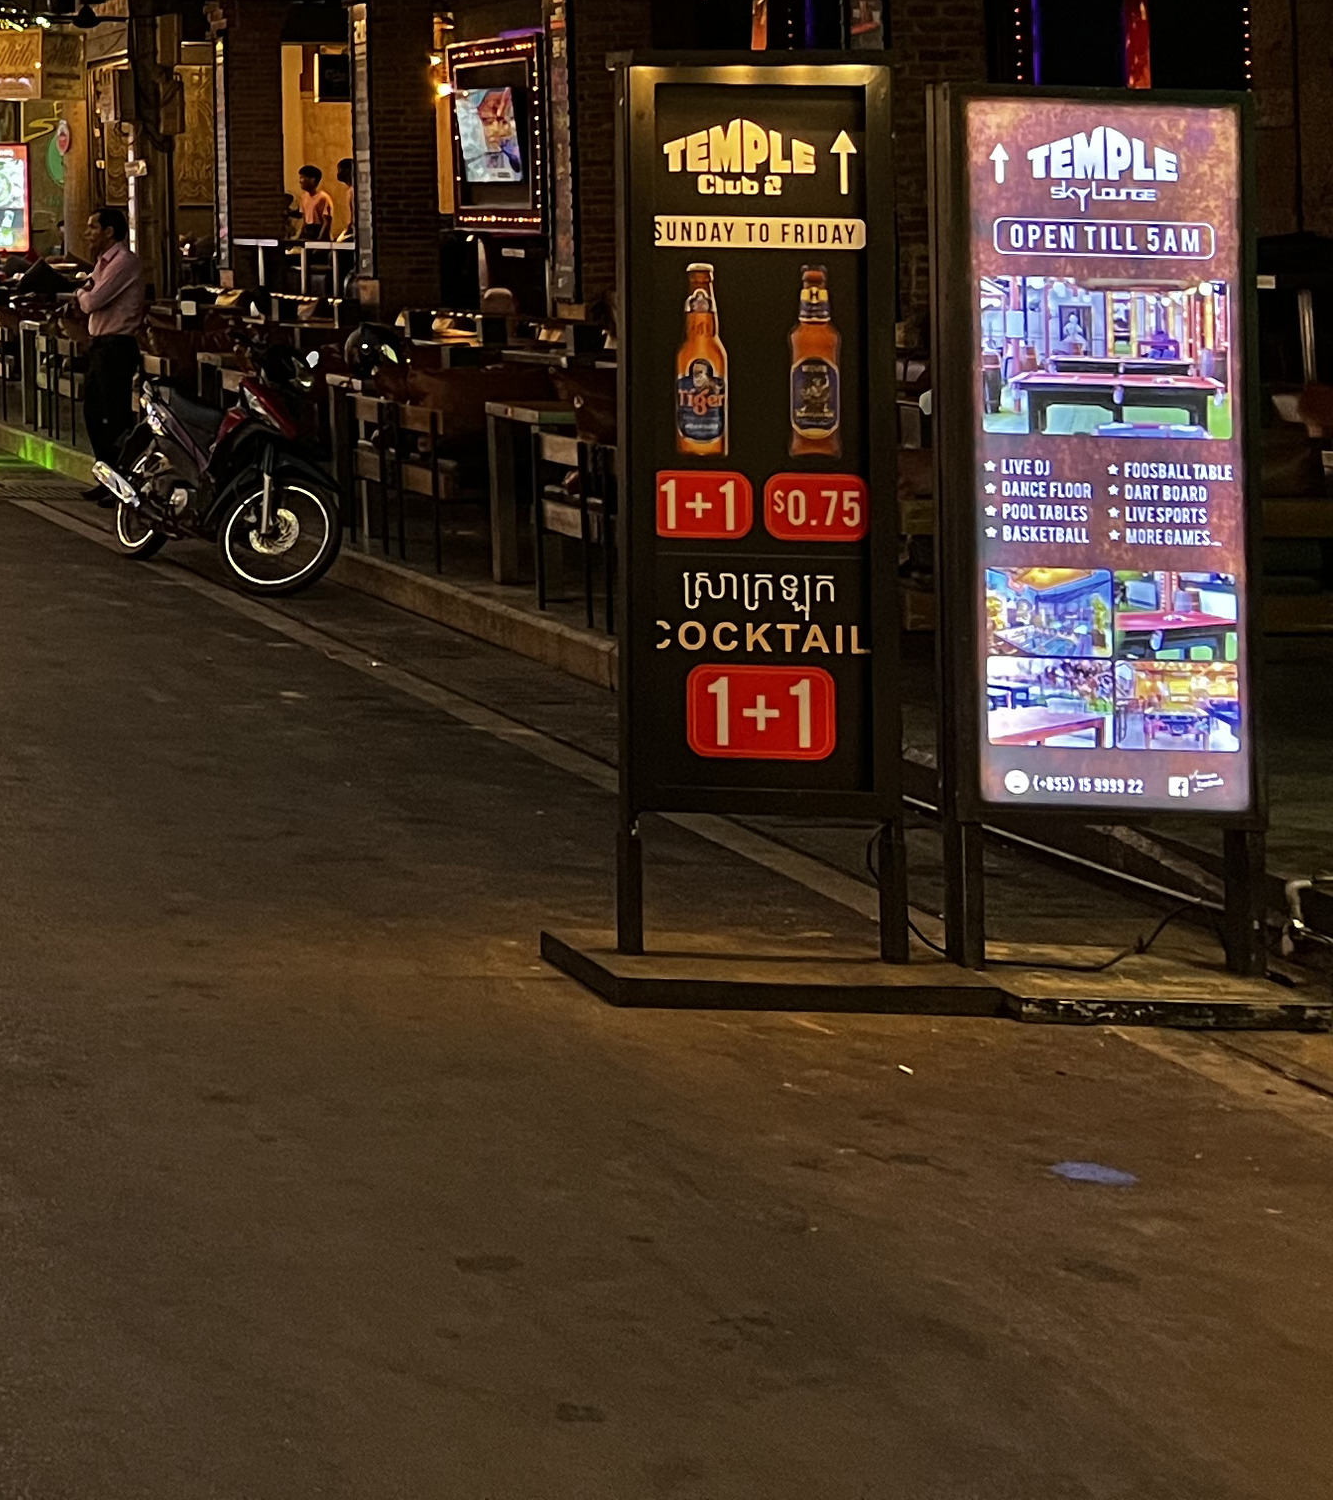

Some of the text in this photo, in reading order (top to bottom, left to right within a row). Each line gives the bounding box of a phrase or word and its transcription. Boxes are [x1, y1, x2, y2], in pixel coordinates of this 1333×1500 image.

[663, 118, 817, 174] TEMPLE
[1026, 125, 1180, 182] TEMPLE
[697, 174, 783, 196] Club 2
[654, 220, 857, 245] SUNDAY TO FRIDAY
[1009, 223, 1201, 253] OPEN TILL 5AM
[677, 388, 725, 416] Tiger
[1000, 458, 1051, 476] LIVE DJ
[1123, 461, 1234, 482] FOOSBALL TABLE
[1001, 480, 1093, 499] DANCE FLOOR
[1124, 484, 1208, 503] DART BOARD
[659, 478, 735, 532] 1+1
[772, 488, 862, 527] $0.75
[1001, 503, 1089, 522] POOL TABLES
[1124, 506, 1208, 525] LIVE SPORTS
[1001, 525, 1090, 545] BASKETBALL
[1124, 529, 1164, 545] MORE
[707, 675, 812, 749] 1+1
[1077, 776, 1093, 792] 15
[1093, 776, 1126, 794] 9999
[1126, 778, 1145, 795] 22
